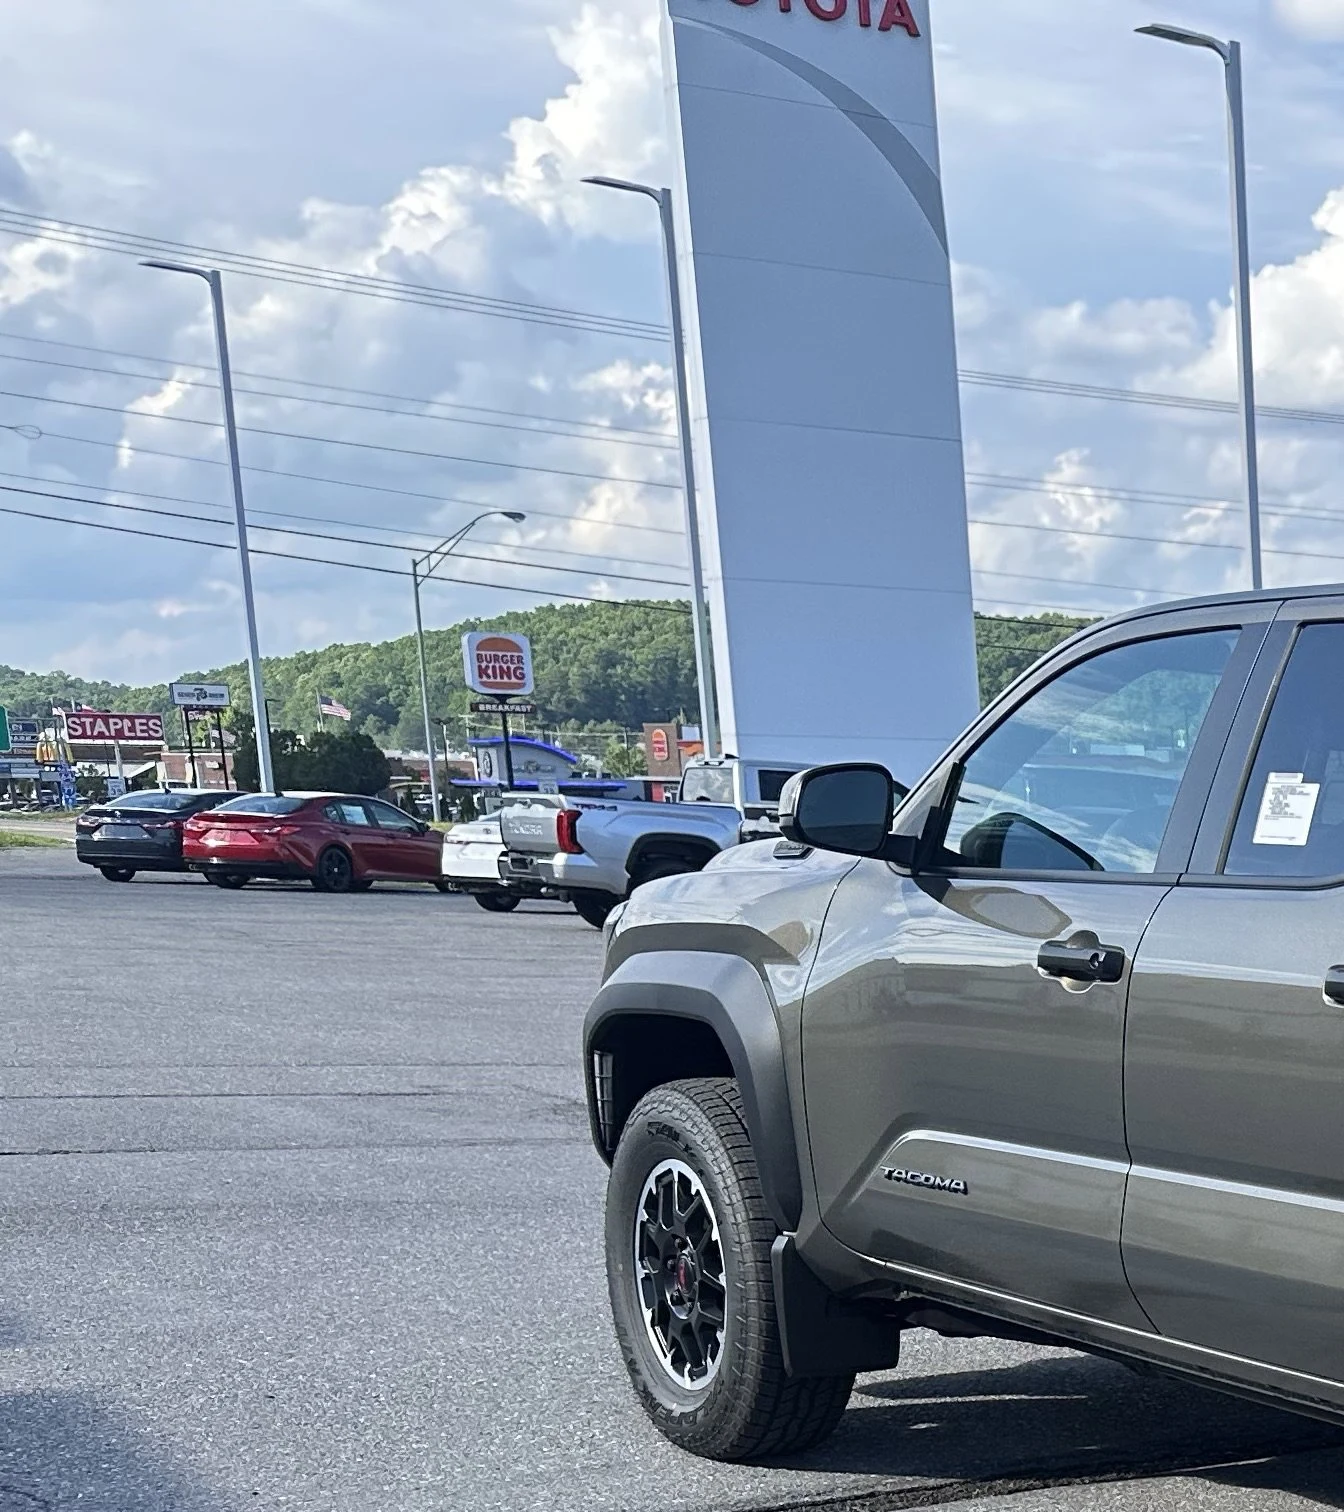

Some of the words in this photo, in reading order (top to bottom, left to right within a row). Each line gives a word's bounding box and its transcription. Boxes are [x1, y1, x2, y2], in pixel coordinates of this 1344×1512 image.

[476, 652, 525, 665] BURGER
[477, 664, 526, 681] KING
[478, 703, 532, 712] BREAKFAST
[66, 716, 163, 738] STAPLES
[880, 1166, 968, 1195] TACOMA
